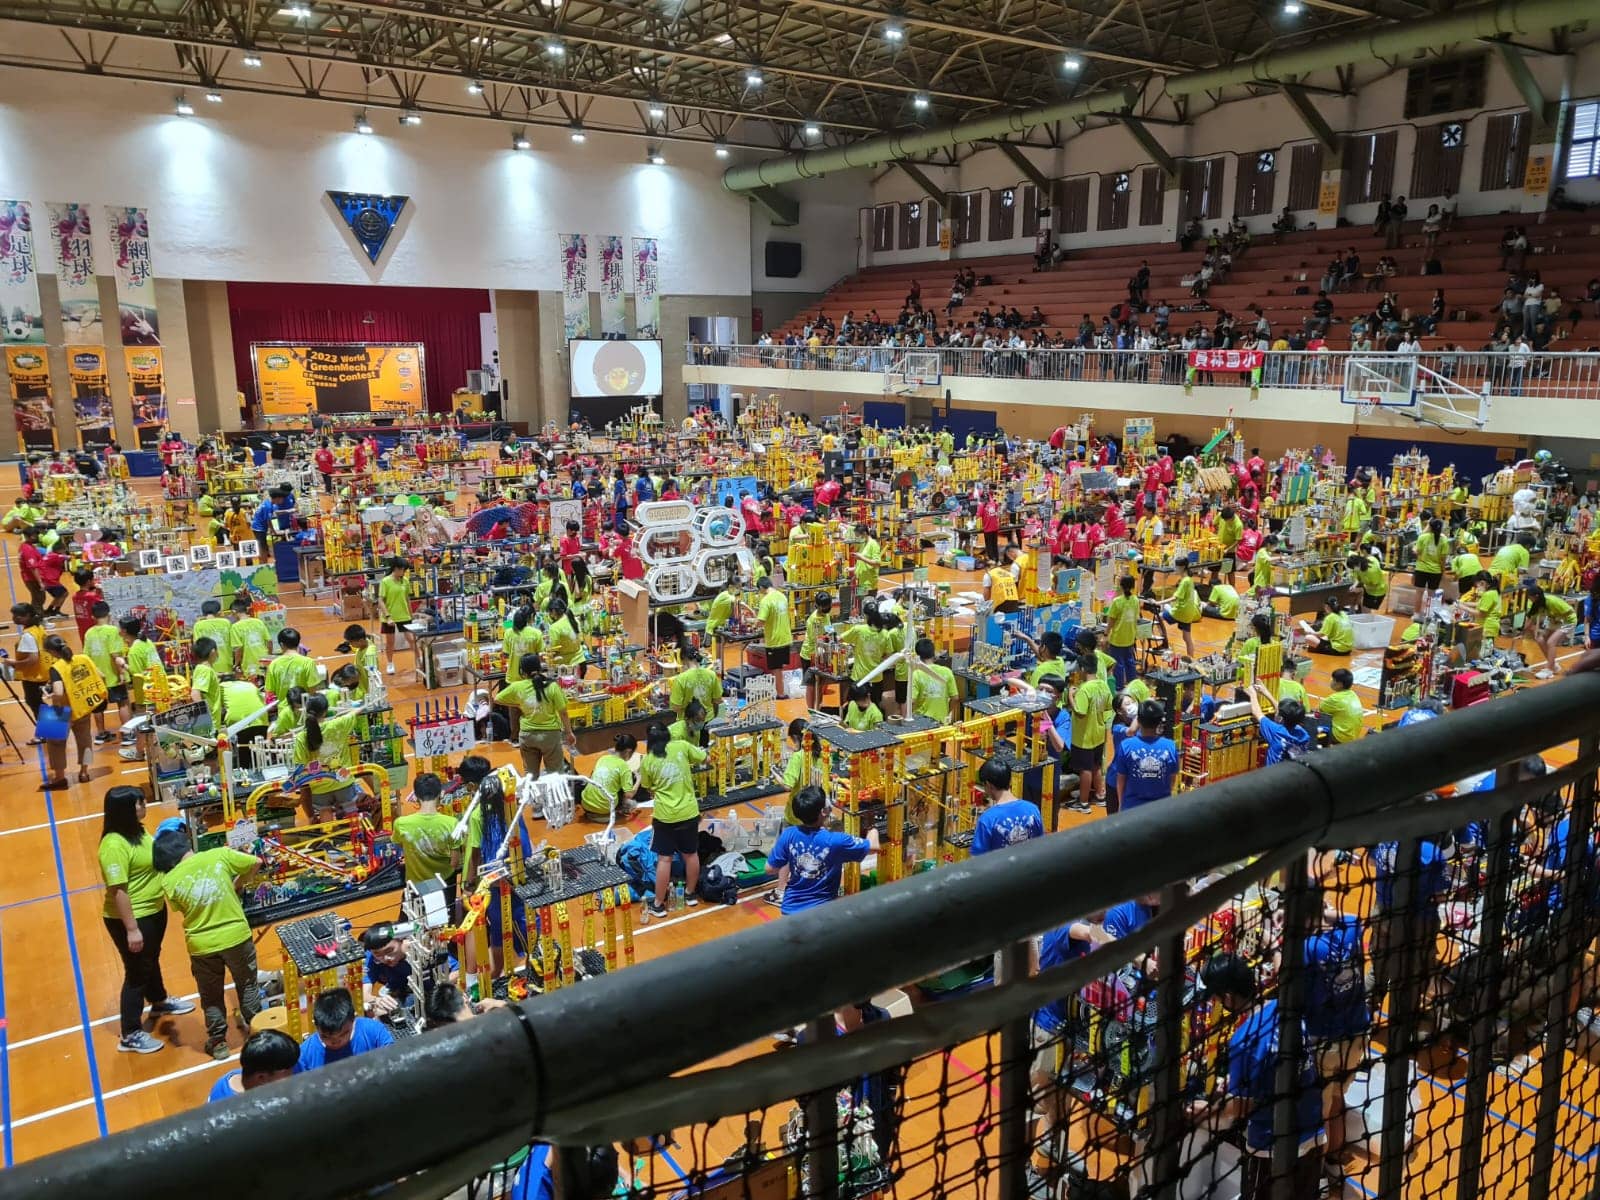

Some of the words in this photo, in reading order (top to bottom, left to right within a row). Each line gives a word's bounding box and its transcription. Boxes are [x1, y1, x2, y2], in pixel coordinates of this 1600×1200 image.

[10, 234, 33, 275] 足球
[71, 238, 94, 276] 羽球
[127, 240, 150, 279] 網球
[573, 262, 586, 292] 桌球
[610, 262, 624, 293] 排球
[310, 351, 338, 363] 2023
[341, 353, 366, 363] World
[1195, 351, 1256, 368] 員林國小
[310, 363, 367, 372] GreenMech
[339, 371, 376, 382] Contest
[73, 681, 101, 699] STAFF
[86, 693, 101, 706] 80
